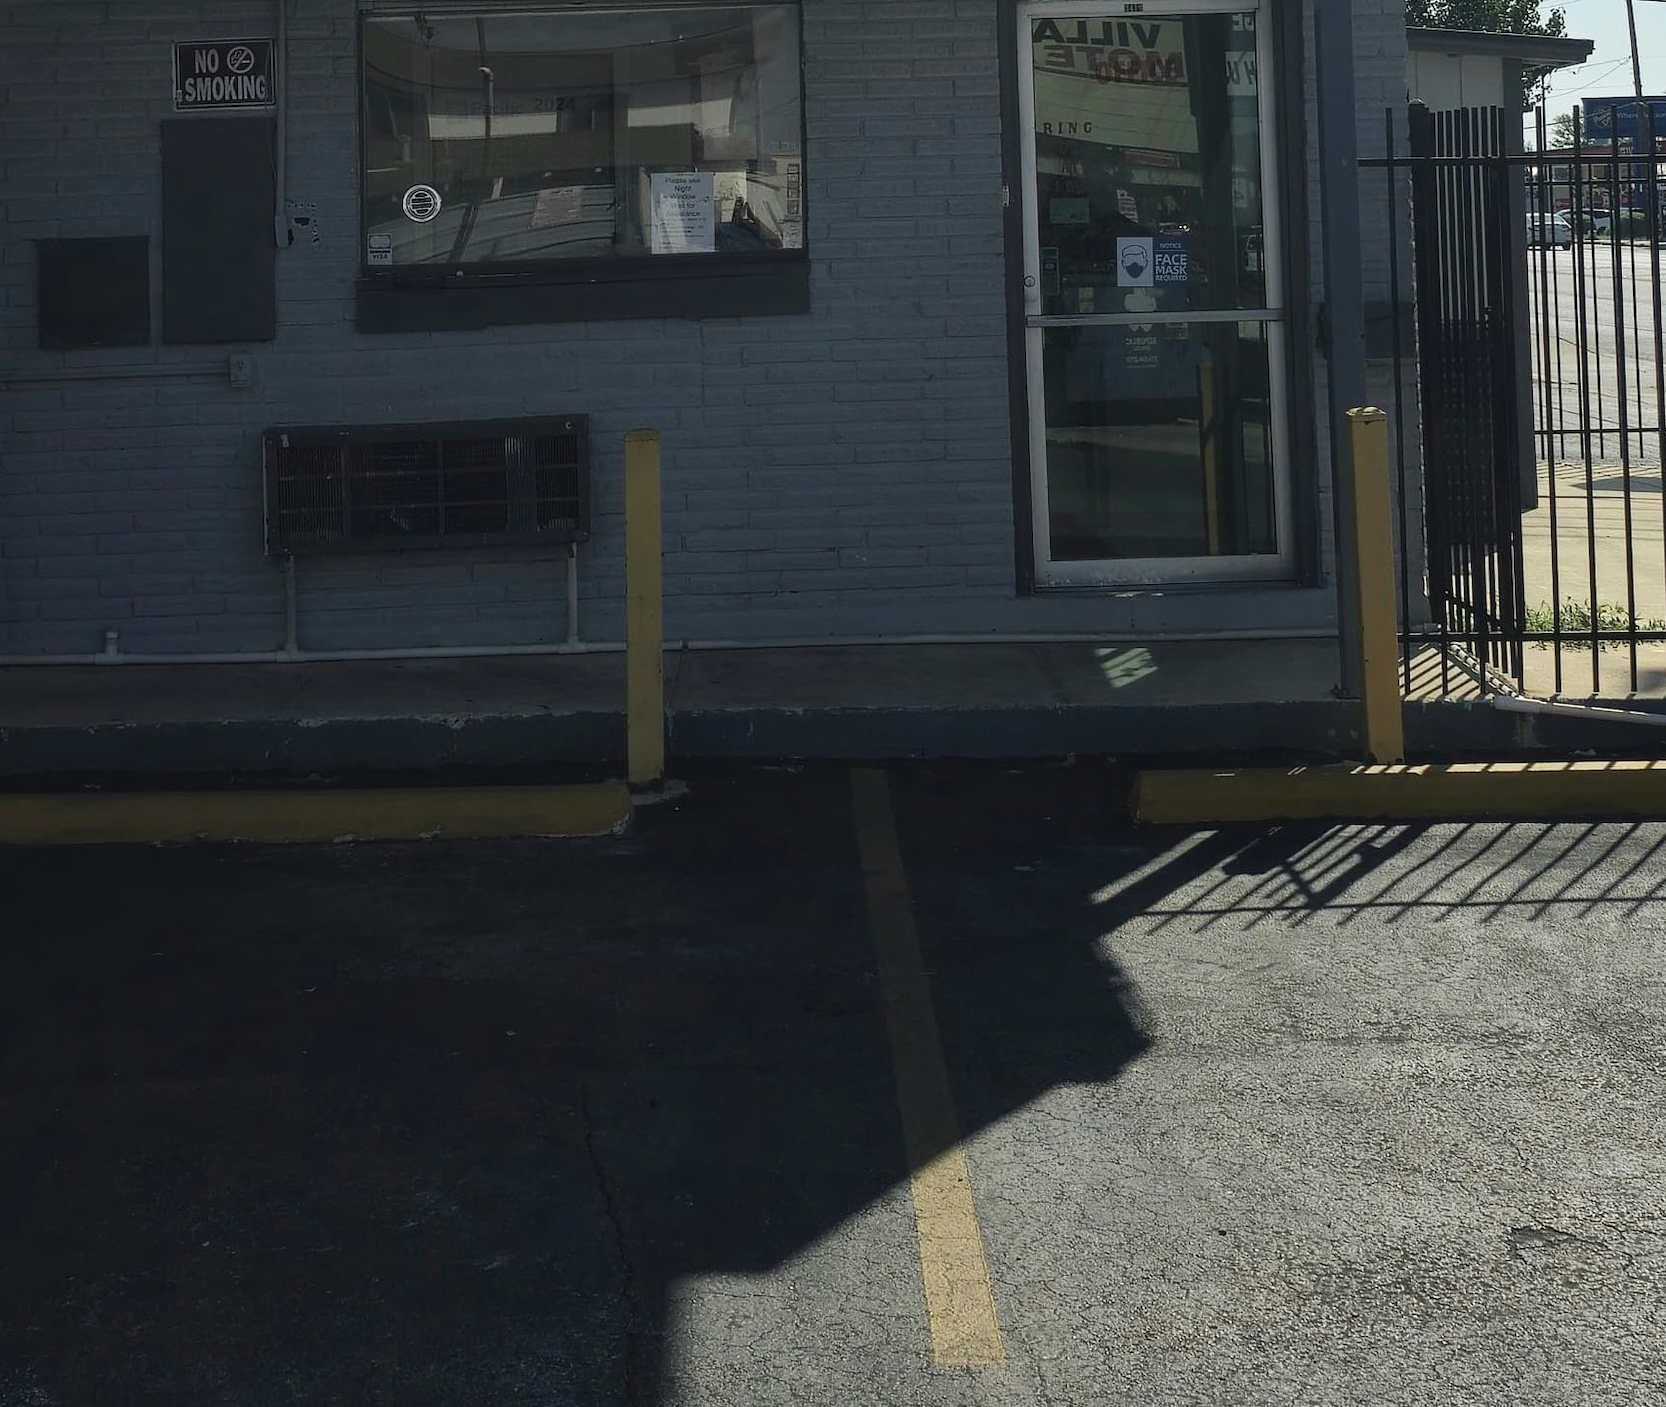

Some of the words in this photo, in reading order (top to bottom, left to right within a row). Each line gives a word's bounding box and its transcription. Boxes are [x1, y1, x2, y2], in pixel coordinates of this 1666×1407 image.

[195, 48, 219, 73] NO
[185, 75, 266, 102] SMOKING
[1043, 121, 1092, 134] RING
[1155, 254, 1187, 265] FACE
[1155, 265, 1188, 275] MASK
